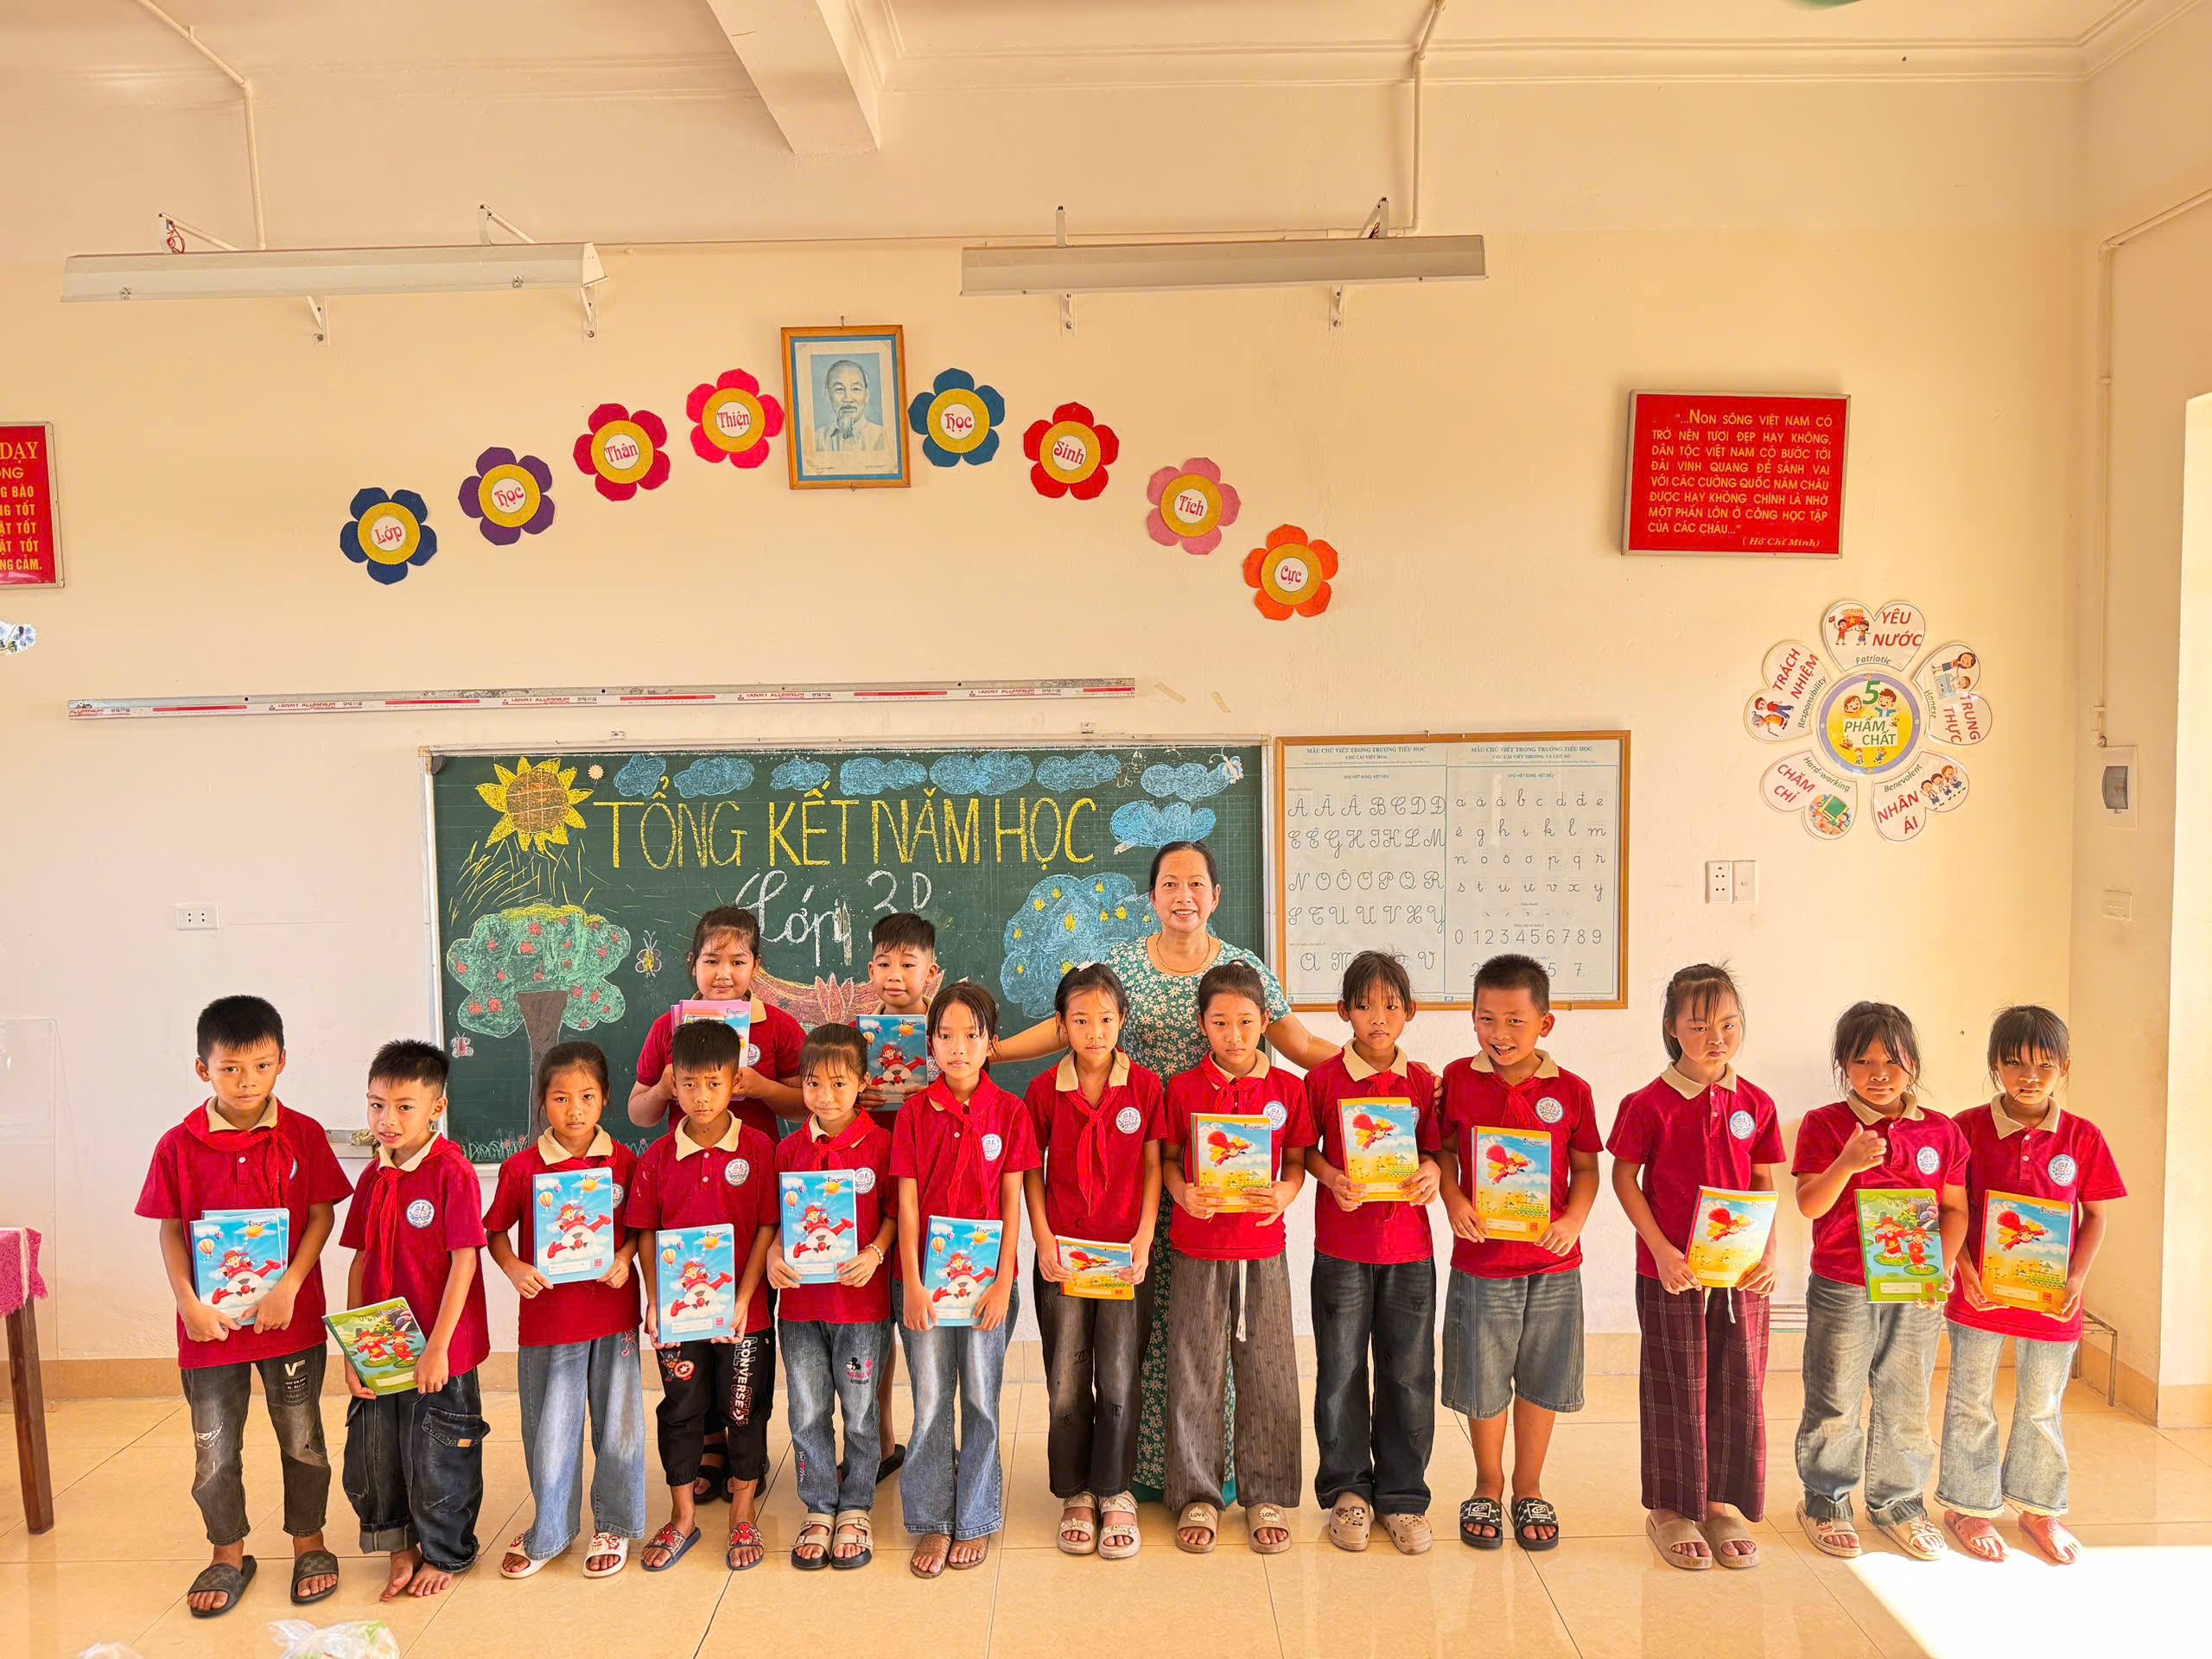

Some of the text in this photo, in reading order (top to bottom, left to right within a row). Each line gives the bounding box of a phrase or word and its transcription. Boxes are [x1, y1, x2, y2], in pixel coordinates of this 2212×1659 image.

[718, 412, 751, 429] Thiện
[1723, 413, 1752, 425] SÔNG
[1760, 414, 1779, 429] VIỆT
[1785, 416, 1809, 426] NAM
[1815, 415, 1832, 428] CÓ
[1652, 429, 1831, 445] TRỞ NÊN TƯƠI ĐẸP HAY KHÔNG,
[0, 442, 39, 463] DẠY
[606, 443, 638, 462] Thân
[1053, 442, 1084, 465] Sinh
[1652, 444, 1831, 460] DÂN TỘC VIỆT NAM CÓ BƯỚC TỚI
[1651, 459, 1829, 475] ĐÀI VINH QUANG ĐỂ SÁNH VAI
[12, 484, 35, 499] BÀO
[1651, 474, 1828, 491] VỚI CÁC CƯỜNG QUỐC NĂM CHÂU
[1179, 494, 1205, 517] Tích
[1649, 492, 1828, 505] ĐƯỢC HAY KHÔNG CHÍNH LÀ NHỜ
[16, 499, 35, 517] TỐT
[1649, 506, 1672, 518] MỘT
[1745, 507, 1777, 519] CÔNG
[1783, 511, 1805, 523] HỌC
[1810, 509, 1827, 523] TẬP
[16, 518, 36, 534] TỐT
[374, 524, 403, 545] Lớp
[1648, 519, 1669, 532] CỦA
[1674, 520, 1696, 533] CÁC
[20, 536, 39, 552] TỐT
[16, 553, 42, 570] CẢM.
[1281, 565, 1301, 584] Cực
[1882, 608, 1911, 625] YÊU
[1872, 632, 1922, 646] NƯỚC
[1855, 655, 1891, 665] Patriotic
[1773, 648, 1801, 691] TRÁCH
[1790, 653, 1819, 699] NHIỆM
[1862, 680, 1881, 705] 5
[1798, 676, 1827, 728] Responsibility
[1924, 690, 1937, 720] Honest
[1844, 715, 1885, 733] PHẨM
[1943, 706, 1962, 743] THỰC
[1959, 694, 1981, 741] TRUNG
[1862, 730, 1896, 747] CHẤT
[1777, 763, 1816, 793] CHĂM
[1803, 756, 1851, 792] Hard-working
[1884, 763, 1923, 793] Benevolent
[1774, 785, 1799, 804] CHỈ
[1877, 791, 1920, 823] NHÂN
[593, 776, 1097, 871] TỔNG KẾT NĂM HỌC
[1903, 816, 1918, 834] ÁI
[1455, 930, 1601, 944] 0 1 2 3 4 5 6 7 8 9
[1548, 963, 1582, 977] 5 7
[734, 1339, 752, 1408] CONVERSE
